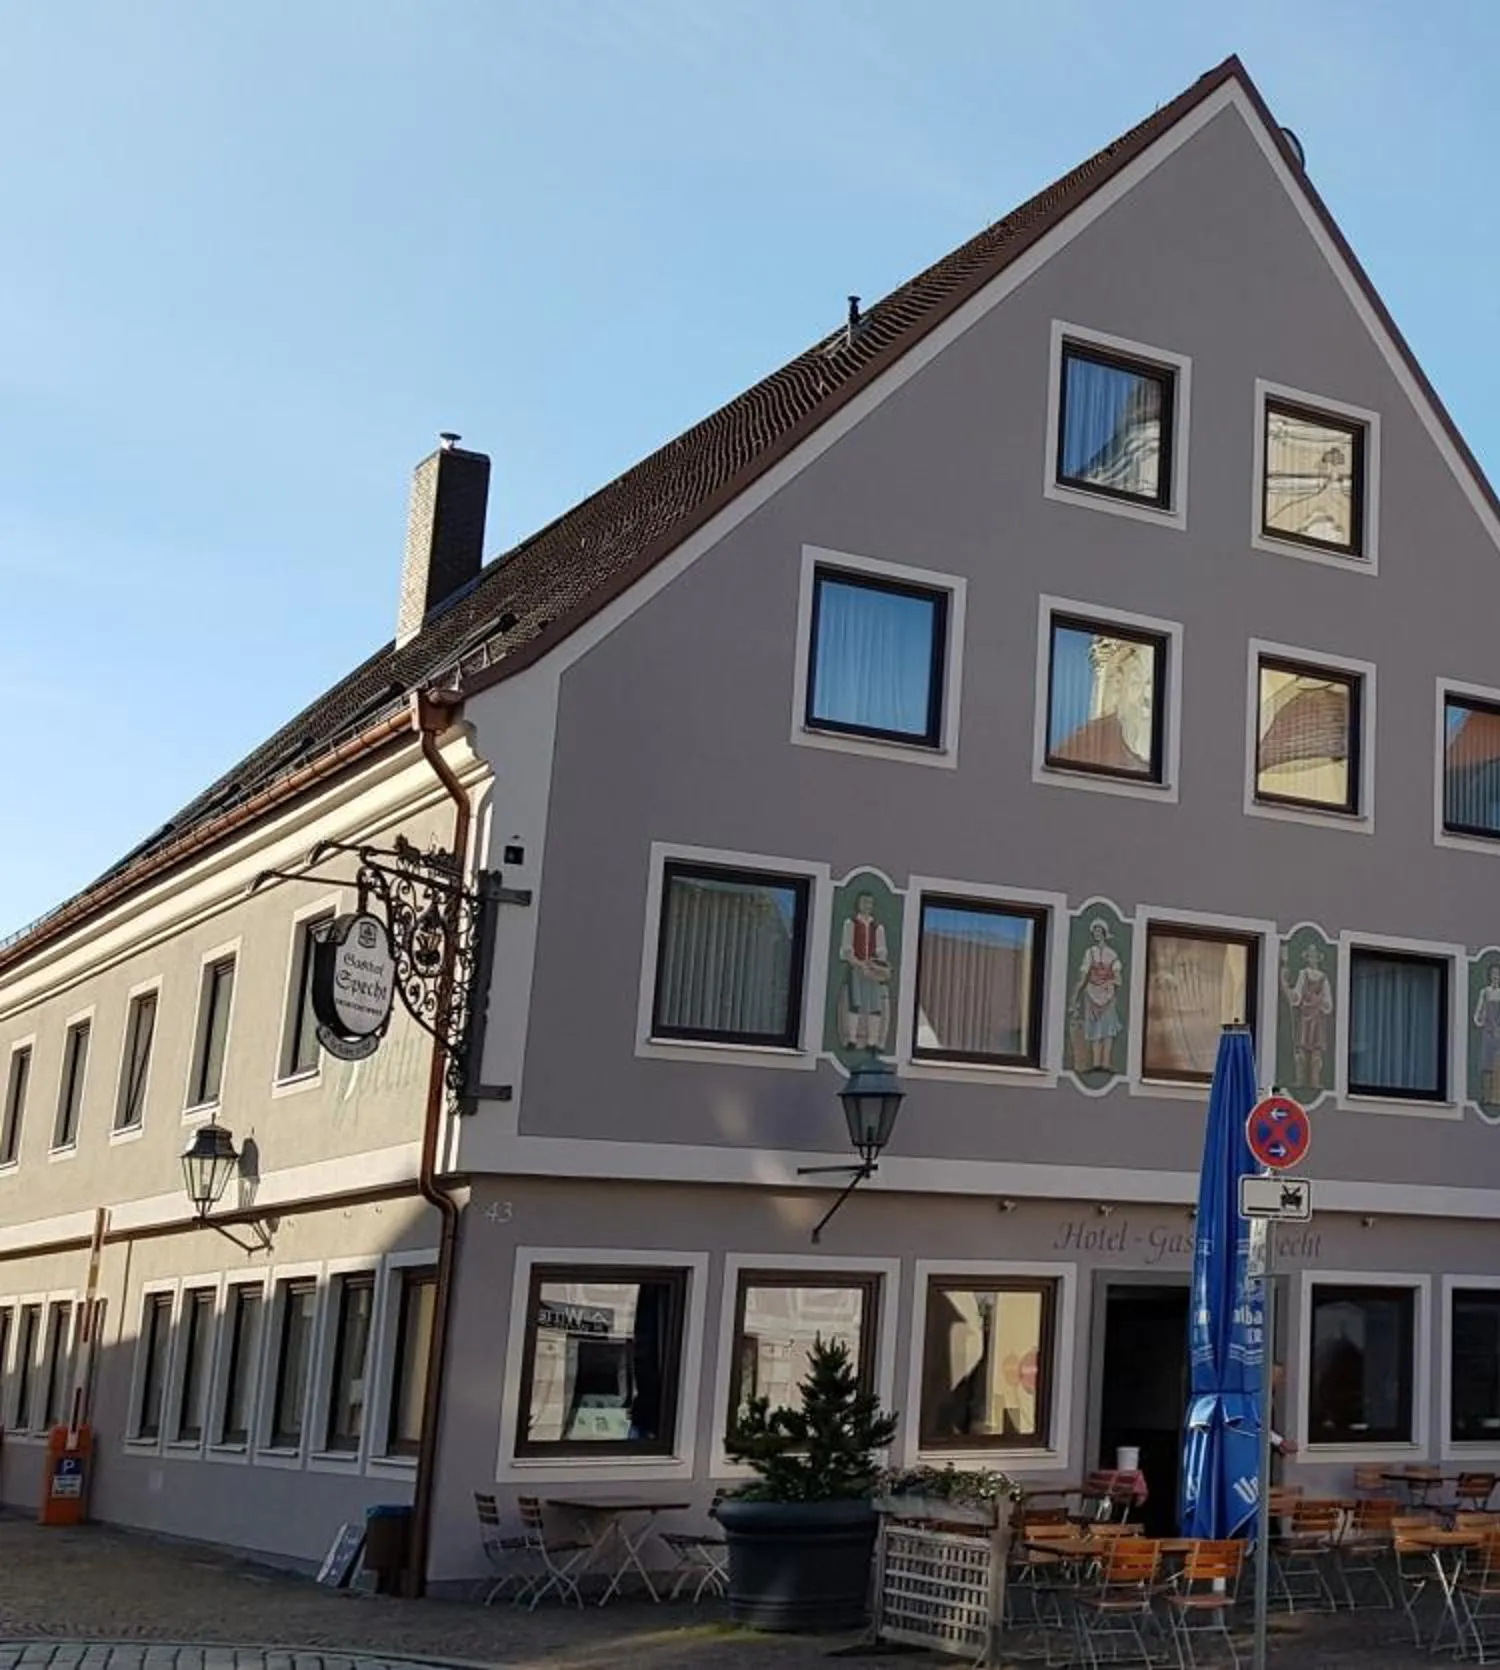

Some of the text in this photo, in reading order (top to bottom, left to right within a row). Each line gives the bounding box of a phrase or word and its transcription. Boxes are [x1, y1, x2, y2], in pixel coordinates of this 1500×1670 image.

[335, 969, 388, 1001] Specht
[484, 1201, 513, 1224] 43
[63, 1458, 76, 1473] P
